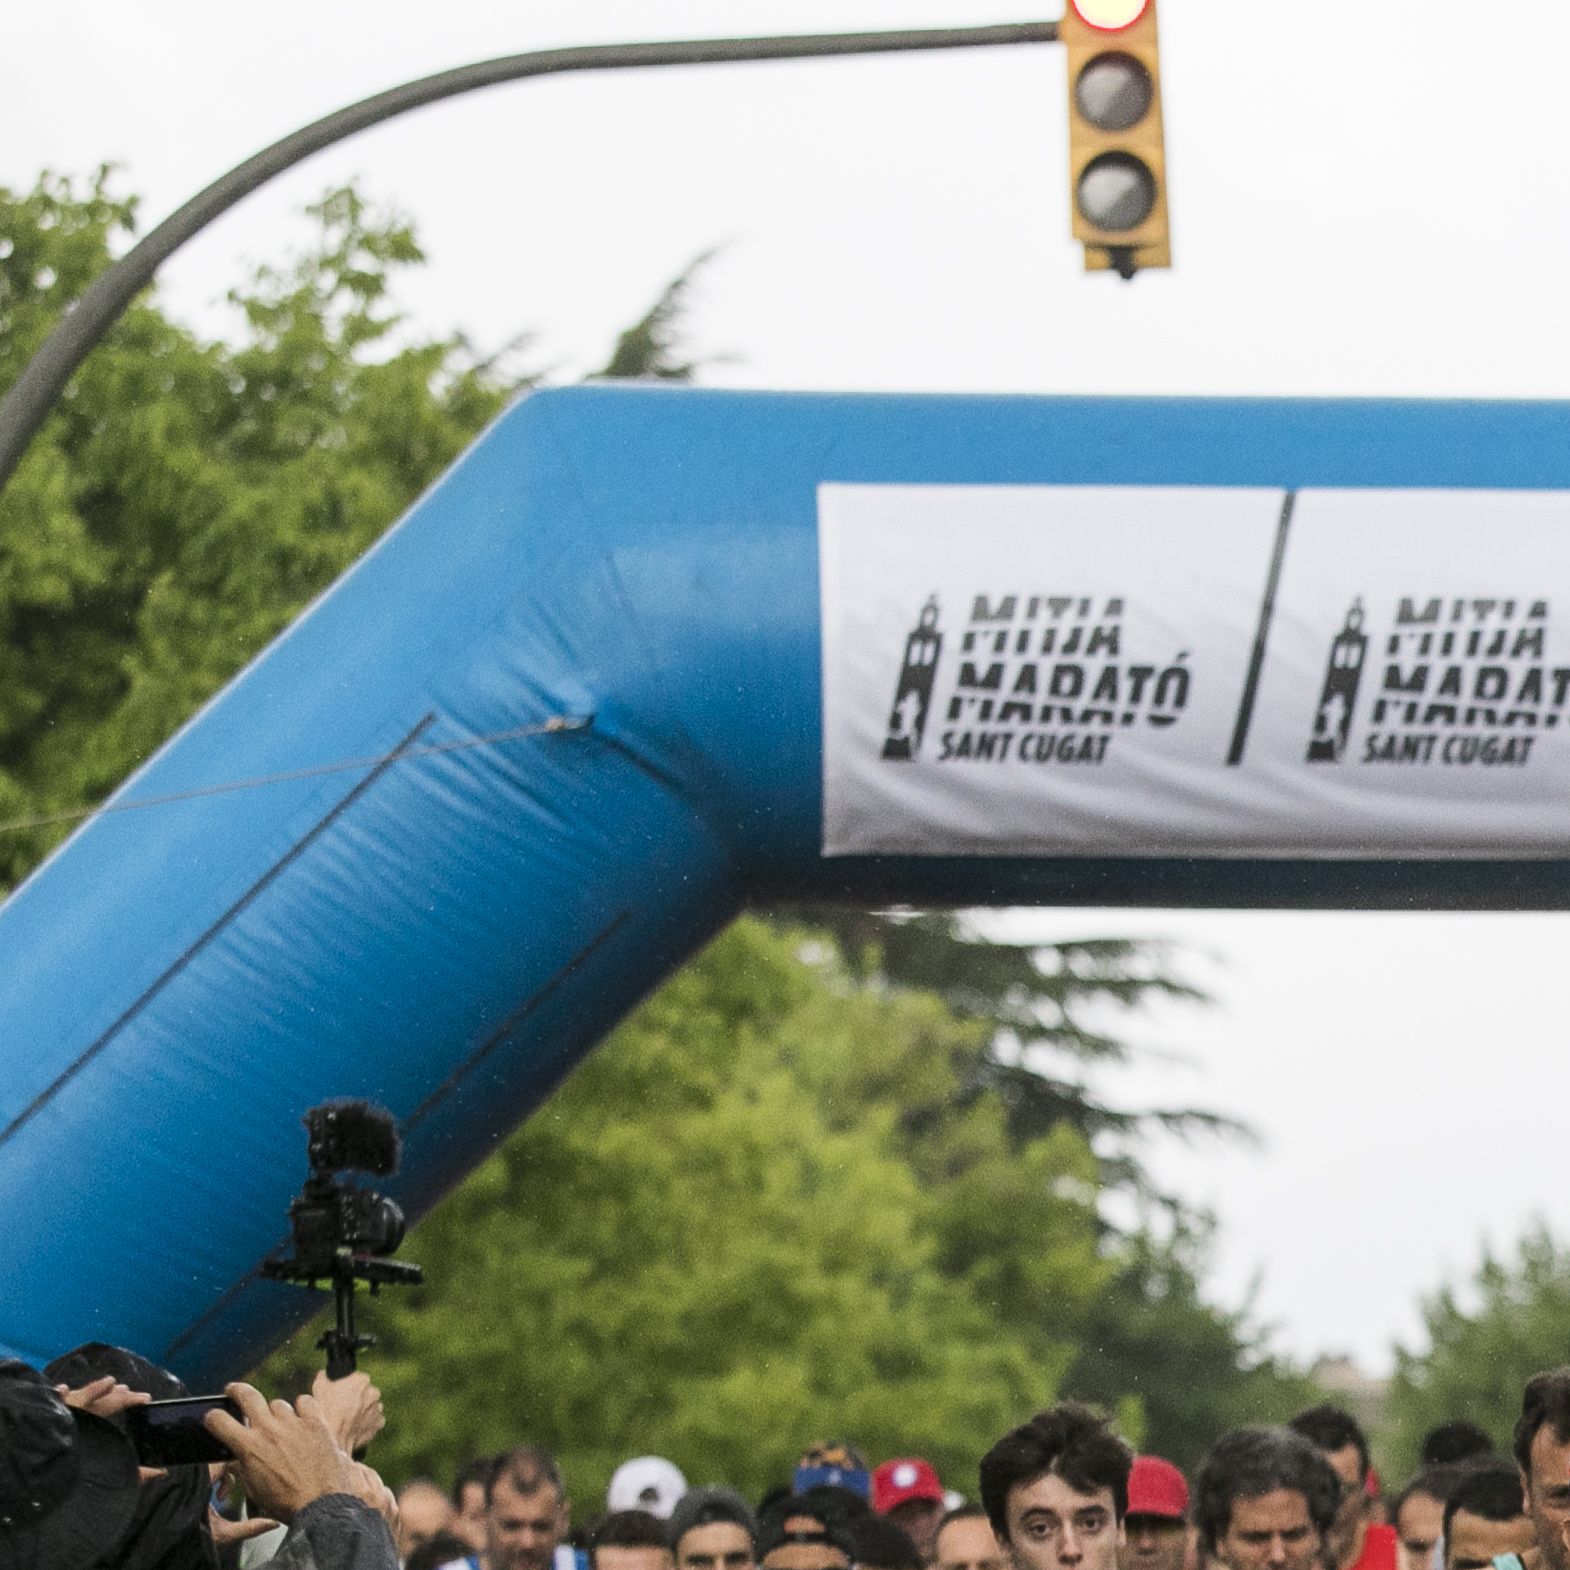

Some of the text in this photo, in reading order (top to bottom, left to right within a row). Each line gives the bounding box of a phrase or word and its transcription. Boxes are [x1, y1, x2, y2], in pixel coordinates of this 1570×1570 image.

[947, 650, 1190, 727] MARATÓ
[937, 733, 1111, 765] SANT CUGAT
[1361, 733, 1535, 766] SANT CUGAT
